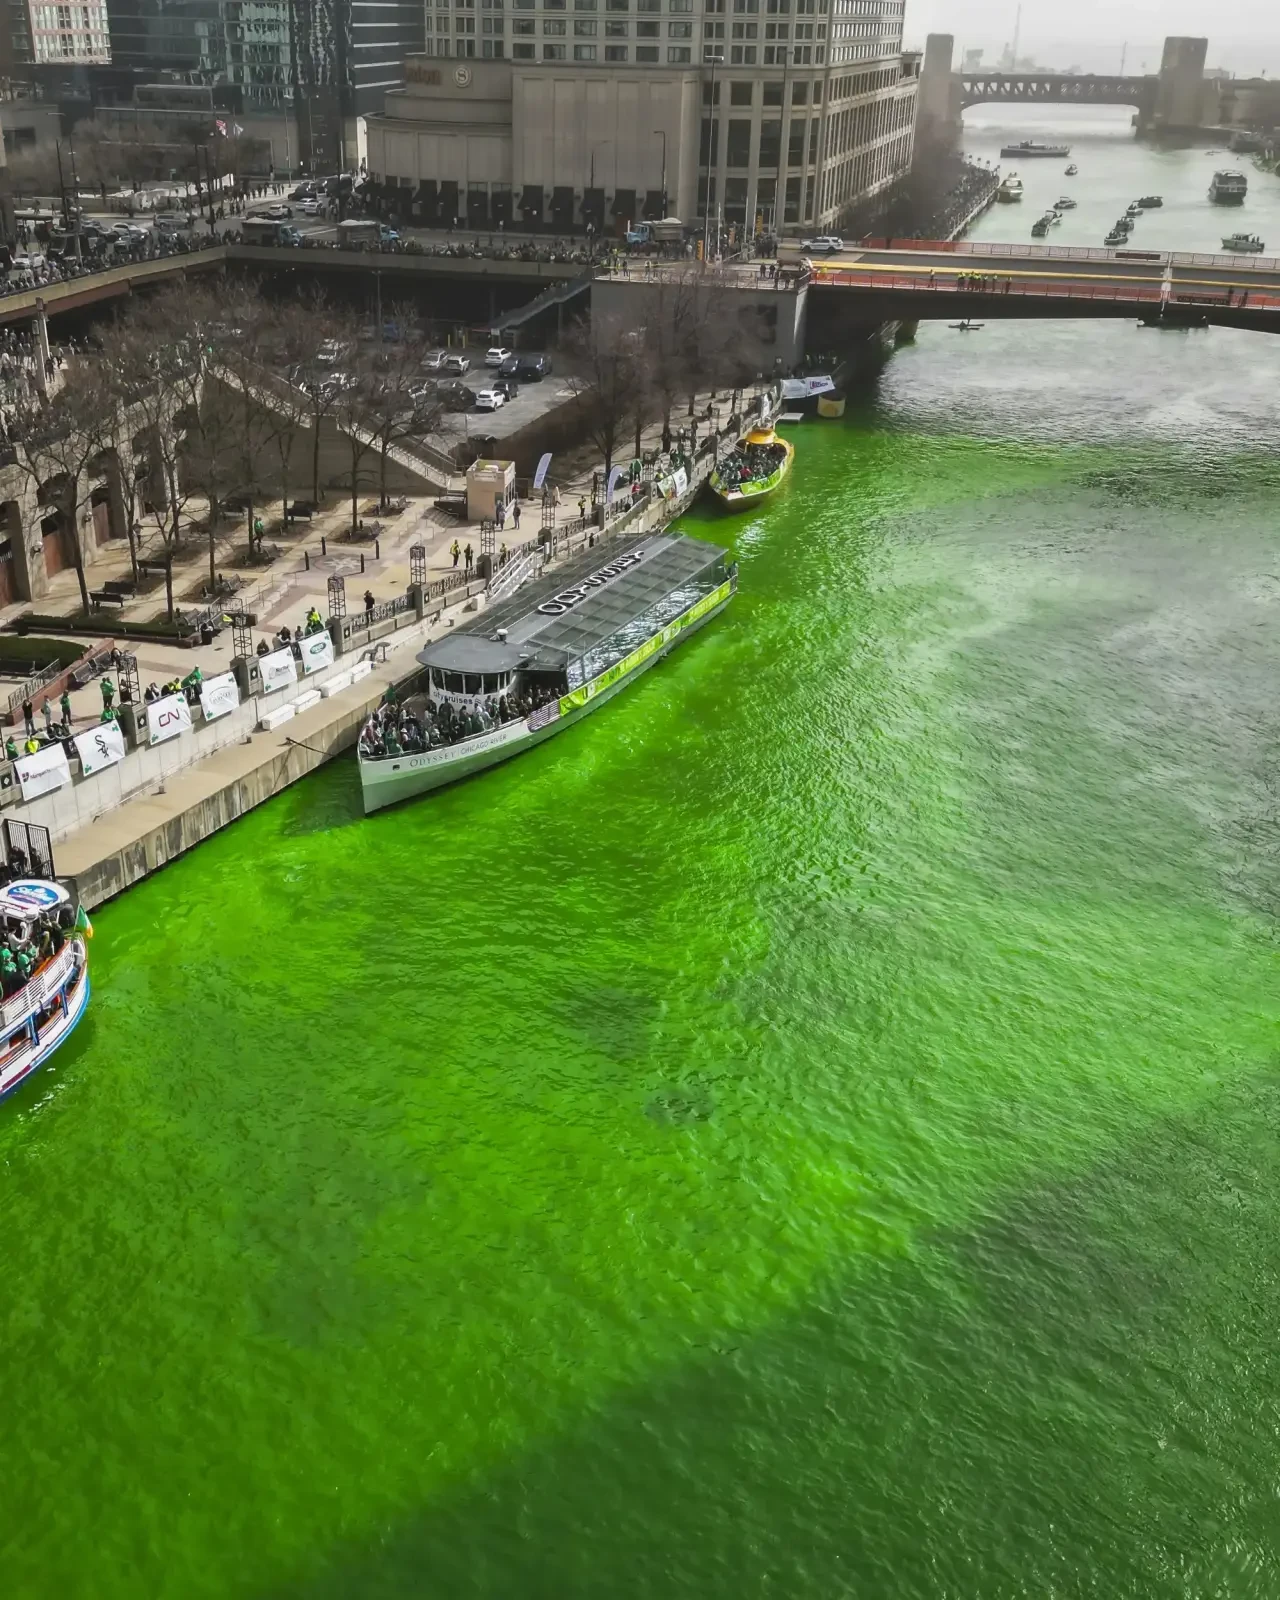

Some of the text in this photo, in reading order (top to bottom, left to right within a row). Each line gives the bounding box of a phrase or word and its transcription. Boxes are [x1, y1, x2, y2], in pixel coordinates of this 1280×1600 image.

[538, 551, 644, 613] ODYSSEY
[159, 708, 180, 727] CN
[410, 733, 507, 767] ODYSSEY CHICAGO RIVER
